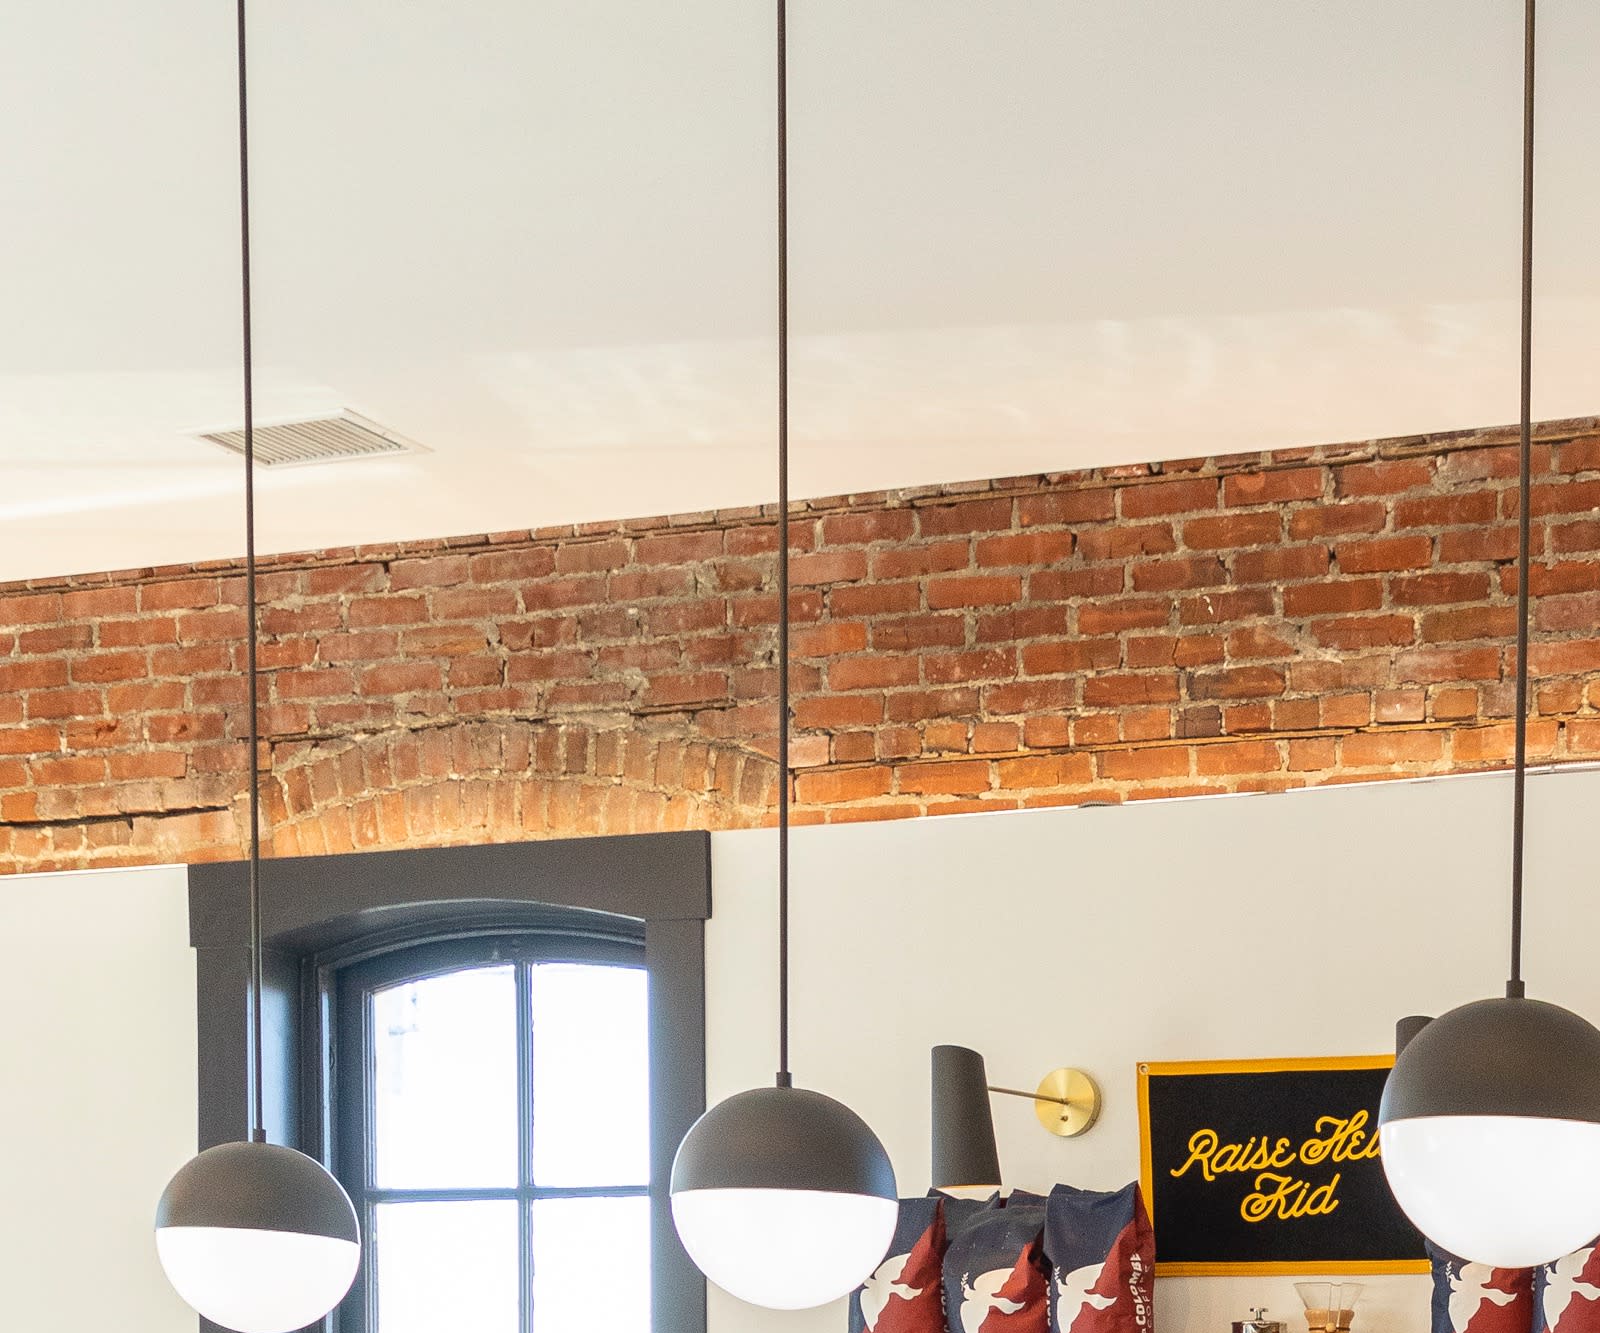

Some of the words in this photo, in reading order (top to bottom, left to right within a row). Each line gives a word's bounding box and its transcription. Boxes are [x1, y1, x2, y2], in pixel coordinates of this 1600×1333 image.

[1170, 1128, 1297, 1182] Raise
[1300, 1109, 1381, 1165] Hel
[1240, 1172, 1341, 1223] Kid
